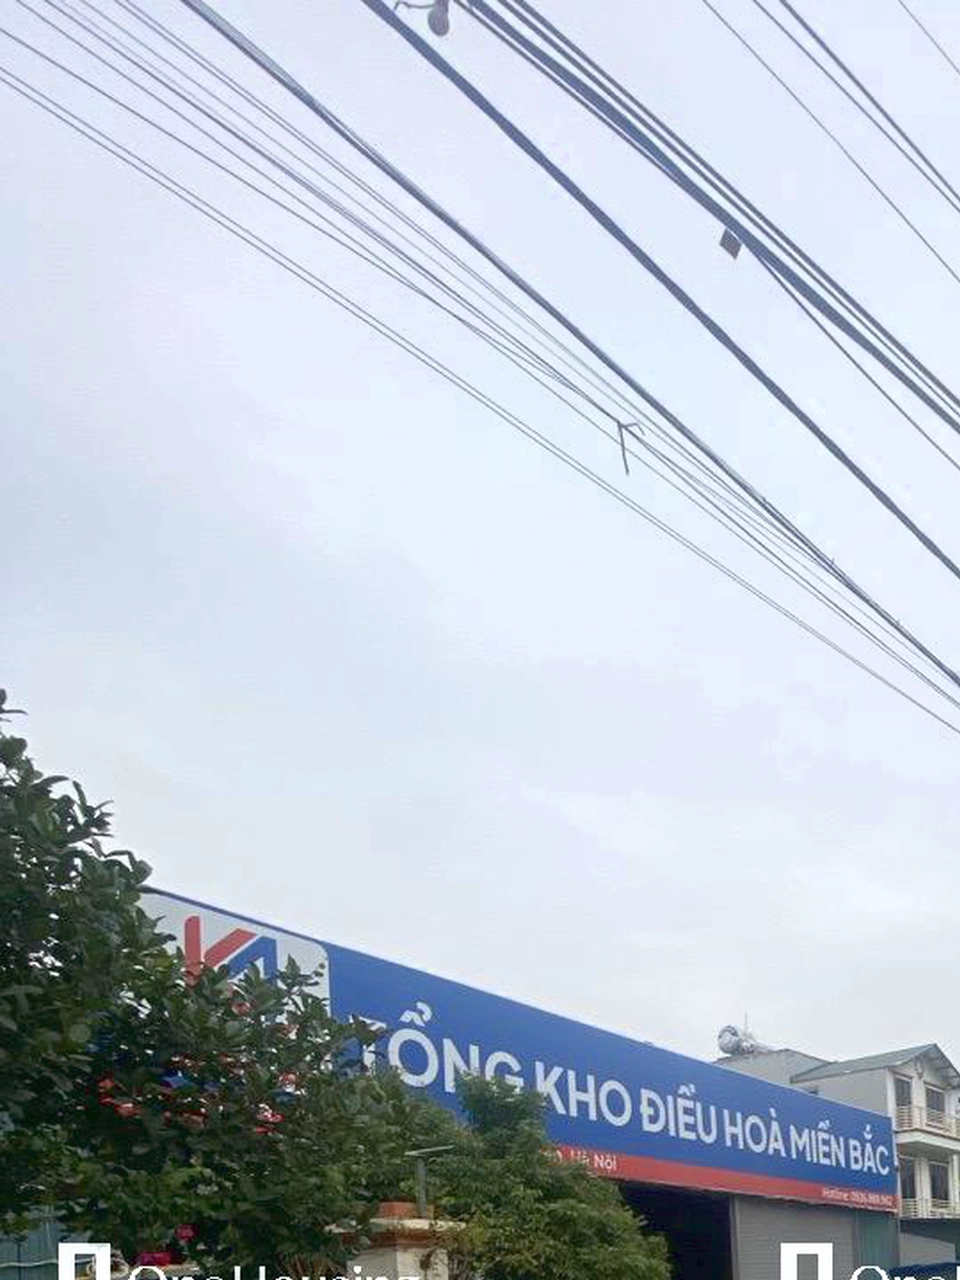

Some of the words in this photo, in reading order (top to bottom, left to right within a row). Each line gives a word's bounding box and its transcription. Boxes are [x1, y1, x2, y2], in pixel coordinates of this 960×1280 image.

[534, 1061, 632, 1127] KHO
[639, 1083, 718, 1144] ĐIỀU
[723, 1108, 787, 1158] HOÀ
[789, 1120, 845, 1168] MIỀN
[849, 1124, 890, 1176] BẮC
